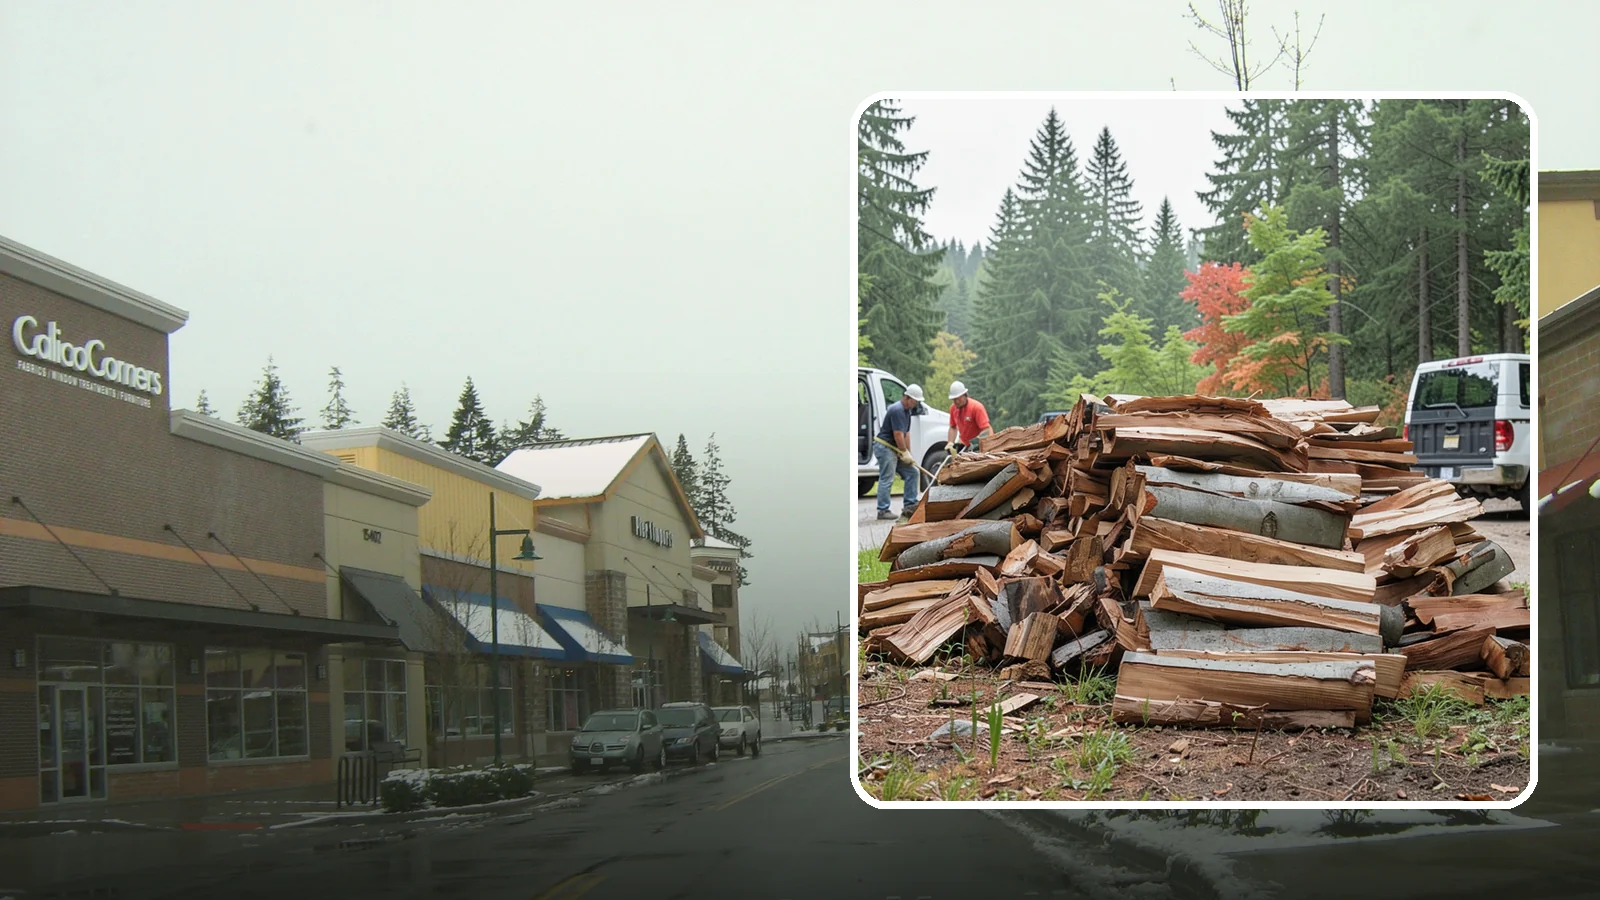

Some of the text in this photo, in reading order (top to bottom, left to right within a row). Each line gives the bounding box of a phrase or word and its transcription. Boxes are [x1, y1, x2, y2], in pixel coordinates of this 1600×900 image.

[17, 360, 151, 408] FABRICS WINDOW TREATMENTS FURNITURE
